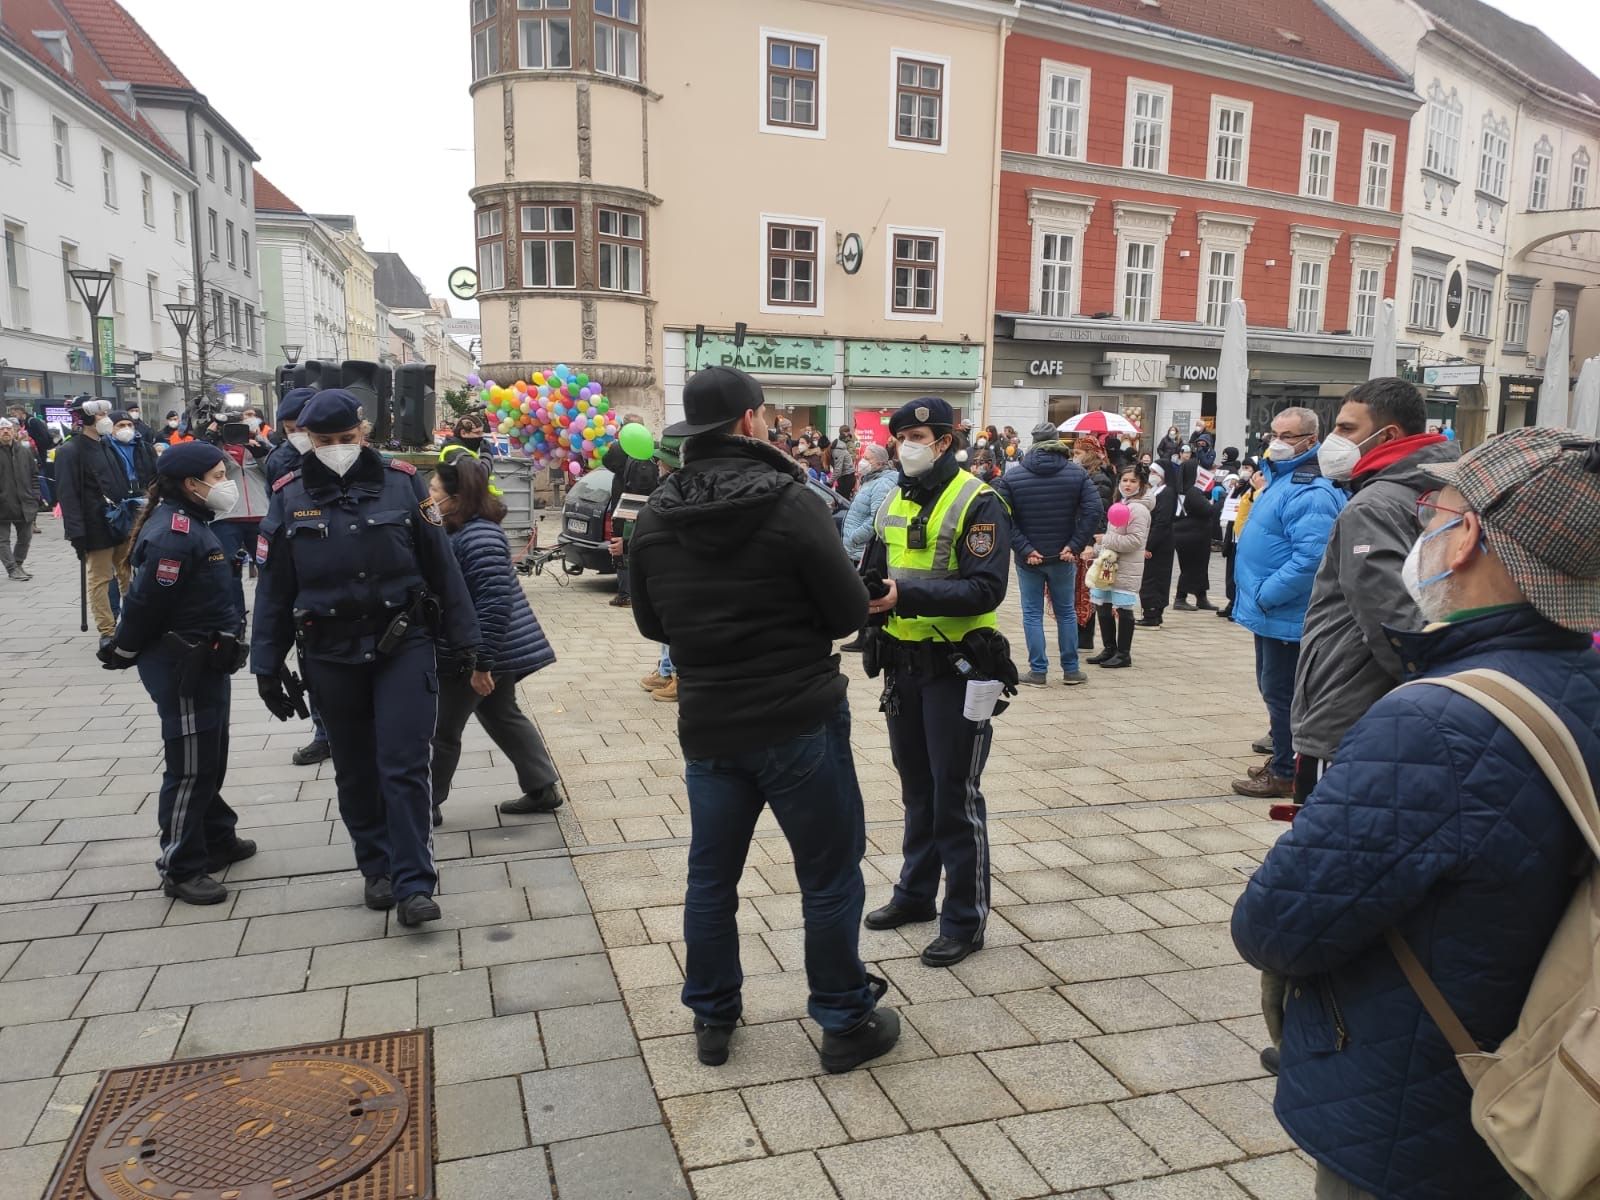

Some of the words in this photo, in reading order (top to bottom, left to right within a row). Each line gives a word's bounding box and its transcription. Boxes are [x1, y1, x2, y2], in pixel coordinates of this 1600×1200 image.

[720, 353, 812, 370] PALMERS
[1030, 360, 1063, 375] CAFE
[1113, 358, 1167, 382] FERSTL
[1183, 365, 1217, 380] KOND
[293, 509, 321, 518] POLIZEI
